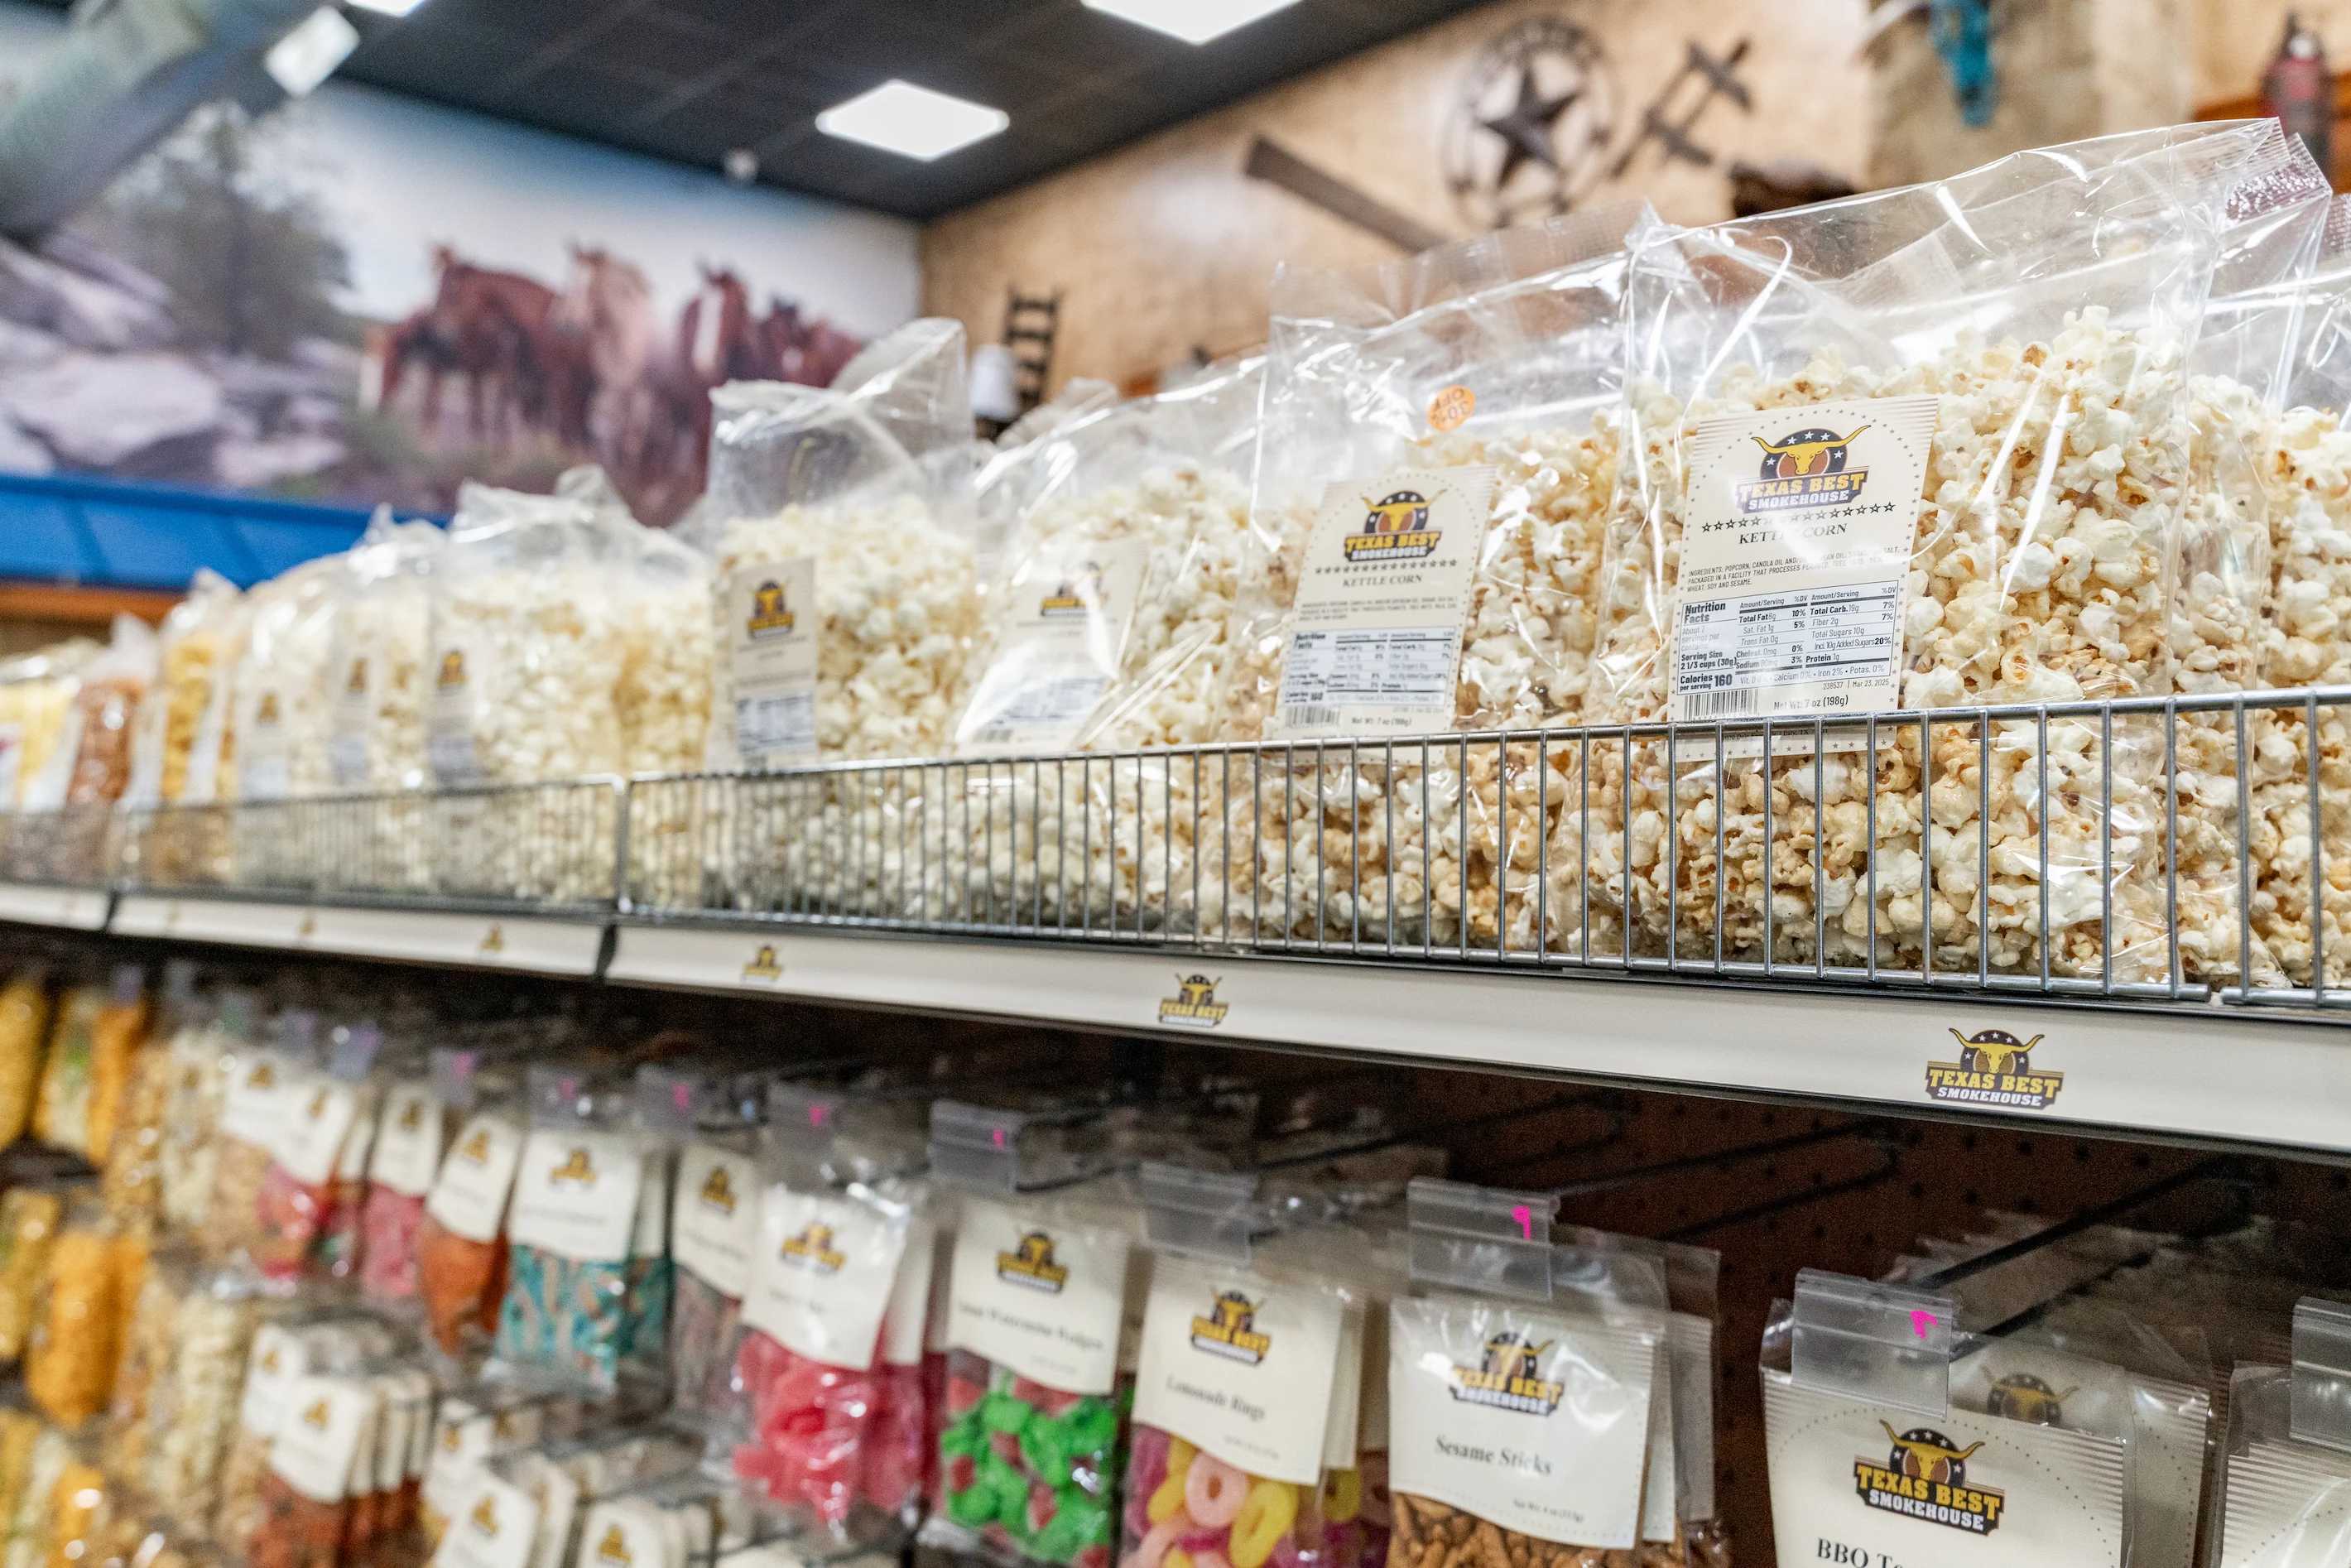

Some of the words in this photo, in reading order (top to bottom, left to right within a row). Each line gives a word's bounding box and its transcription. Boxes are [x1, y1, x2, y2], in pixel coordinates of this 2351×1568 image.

[1738, 479, 1803, 503] TEXAS
[1809, 473, 1865, 493] BEST
[1748, 489, 1850, 510] SMOKEHOUSE
[1738, 527, 1800, 545] KETT
[1803, 522, 1848, 538] CORN
[1345, 535, 1395, 554] TEXAS
[1397, 531, 1440, 548] BEST
[1689, 567, 1724, 577] INGREDIENTS:
[1726, 563, 1751, 572] POPCORN,
[1752, 560, 1773, 569] CANOLA
[1785, 555, 1807, 565] AND/O
[1689, 575, 1714, 584] PACKAGED
[1728, 570, 1752, 579] FACILITY
[1754, 568, 1767, 576] THAT
[1769, 565, 1801, 575] PROCESSES
[1688, 584, 1705, 593] WHEAT,
[1731, 579, 1752, 587] SESAME.
[1812, 591, 1859, 600] Amount/Serving
[1882, 586, 1897, 594] %DV
[1685, 602, 1726, 614] Nutrition
[1741, 599, 1785, 608] Amount/Serving
[1795, 594, 1808, 603] %DV
[1810, 607, 1828, 615] Total
[1830, 605, 1848, 613] Carb.
[1849, 604, 1859, 613] 19g
[1883, 601, 1895, 609] 7%
[1685, 613, 1710, 624] Facts
[1739, 615, 1756, 623] Total
[1768, 613, 1776, 622] 8g
[1793, 609, 1806, 618] 10%
[1813, 618, 1829, 627] Fiber
[1831, 618, 1839, 627] 2g
[1882, 613, 1894, 621] 7%
[1682, 627, 1700, 636] About
[1701, 626, 1706, 634] 7
[1743, 626, 1755, 634] Sat.
[1757, 624, 1767, 632] Fat
[1768, 623, 1775, 632] 1g
[1794, 620, 1805, 628] 5%
[1812, 630, 1828, 638] Total
[1829, 628, 1852, 638] Sugars
[1854, 628, 1865, 637] 10g
[1682, 635, 1708, 644] servings
[1709, 633, 1720, 642] per
[1760, 636, 1769, 644] Fat
[1771, 635, 1779, 644] 0g
[1827, 642, 1836, 651] 10g
[1837, 640, 1854, 648] Added
[1855, 638, 1875, 648] Sugars
[1875, 637, 1892, 645] 20%
[1681, 652, 1708, 661] Serving
[1709, 651, 1723, 659] Size
[1764, 648, 1777, 657] 0mg
[1792, 644, 1804, 652] 0%
[1687, 661, 1698, 670] 1/3
[1700, 661, 1716, 669] cups
[1718, 657, 1738, 667] (30g)
[1737, 661, 1760, 670] Sodium
[1791, 656, 1803, 664] 3%
[1806, 654, 1831, 663] Protein
[1834, 653, 1840, 662] 1g
[1680, 674, 1714, 684] Calories
[1714, 674, 1733, 687] 160
[1741, 676, 1750, 685] Vit.
[1775, 672, 1799, 682] Calcium
[1801, 671, 1811, 679] 0%
[1818, 669, 1830, 677] Iron
[1833, 668, 1844, 676] 2%
[1850, 666, 1871, 675] Potas.
[1873, 665, 1885, 673] 0%
[1824, 682, 1844, 690] 238537
[1853, 681, 1863, 689] Mar
[1864, 680, 1873, 688] 23,
[1875, 679, 1890, 687] 2025
[1775, 701, 1788, 711] Net
[1805, 700, 1810, 708] 7
[1812, 700, 1821, 708] oz
[1823, 695, 1849, 708] (198g)
[1929, 1069, 1996, 1090] TEXAS
[2000, 1075, 2060, 1099] BEST
[1937, 1086, 2043, 1106] SMOKEHOUSE
[1434, 1434, 1494, 1464] Sesame
[1498, 1447, 1553, 1475] Sticks
[1857, 1465, 1929, 1500] TEXAS
[1935, 1483, 2001, 1521] BEST
[1868, 1489, 1984, 1532] SMOKEHOUSE
